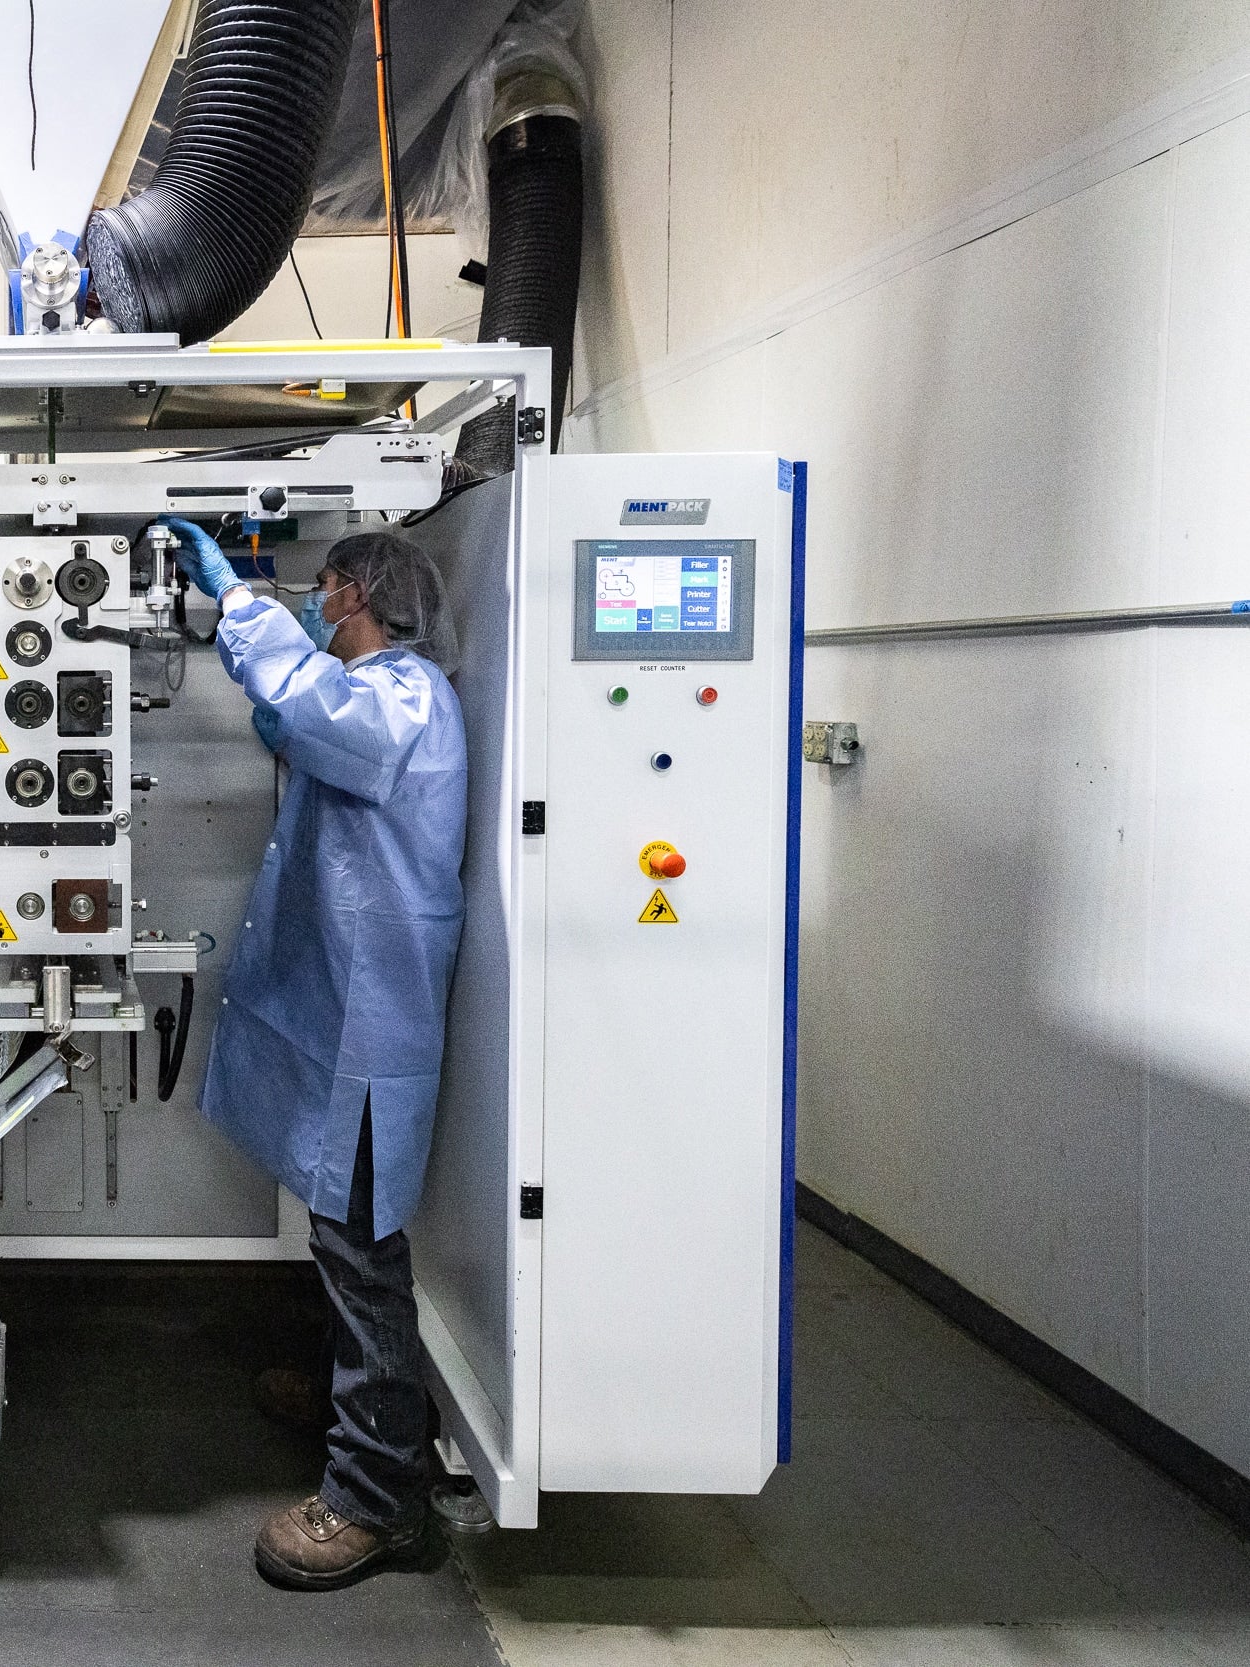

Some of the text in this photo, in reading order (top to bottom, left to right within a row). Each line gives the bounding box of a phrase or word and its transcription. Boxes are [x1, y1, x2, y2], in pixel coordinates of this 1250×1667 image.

[628, 501, 705, 512] MENTPACK
[691, 561, 709, 569] Filler
[604, 616, 627, 624] Start
[642, 844, 671, 860] EMERGEN
